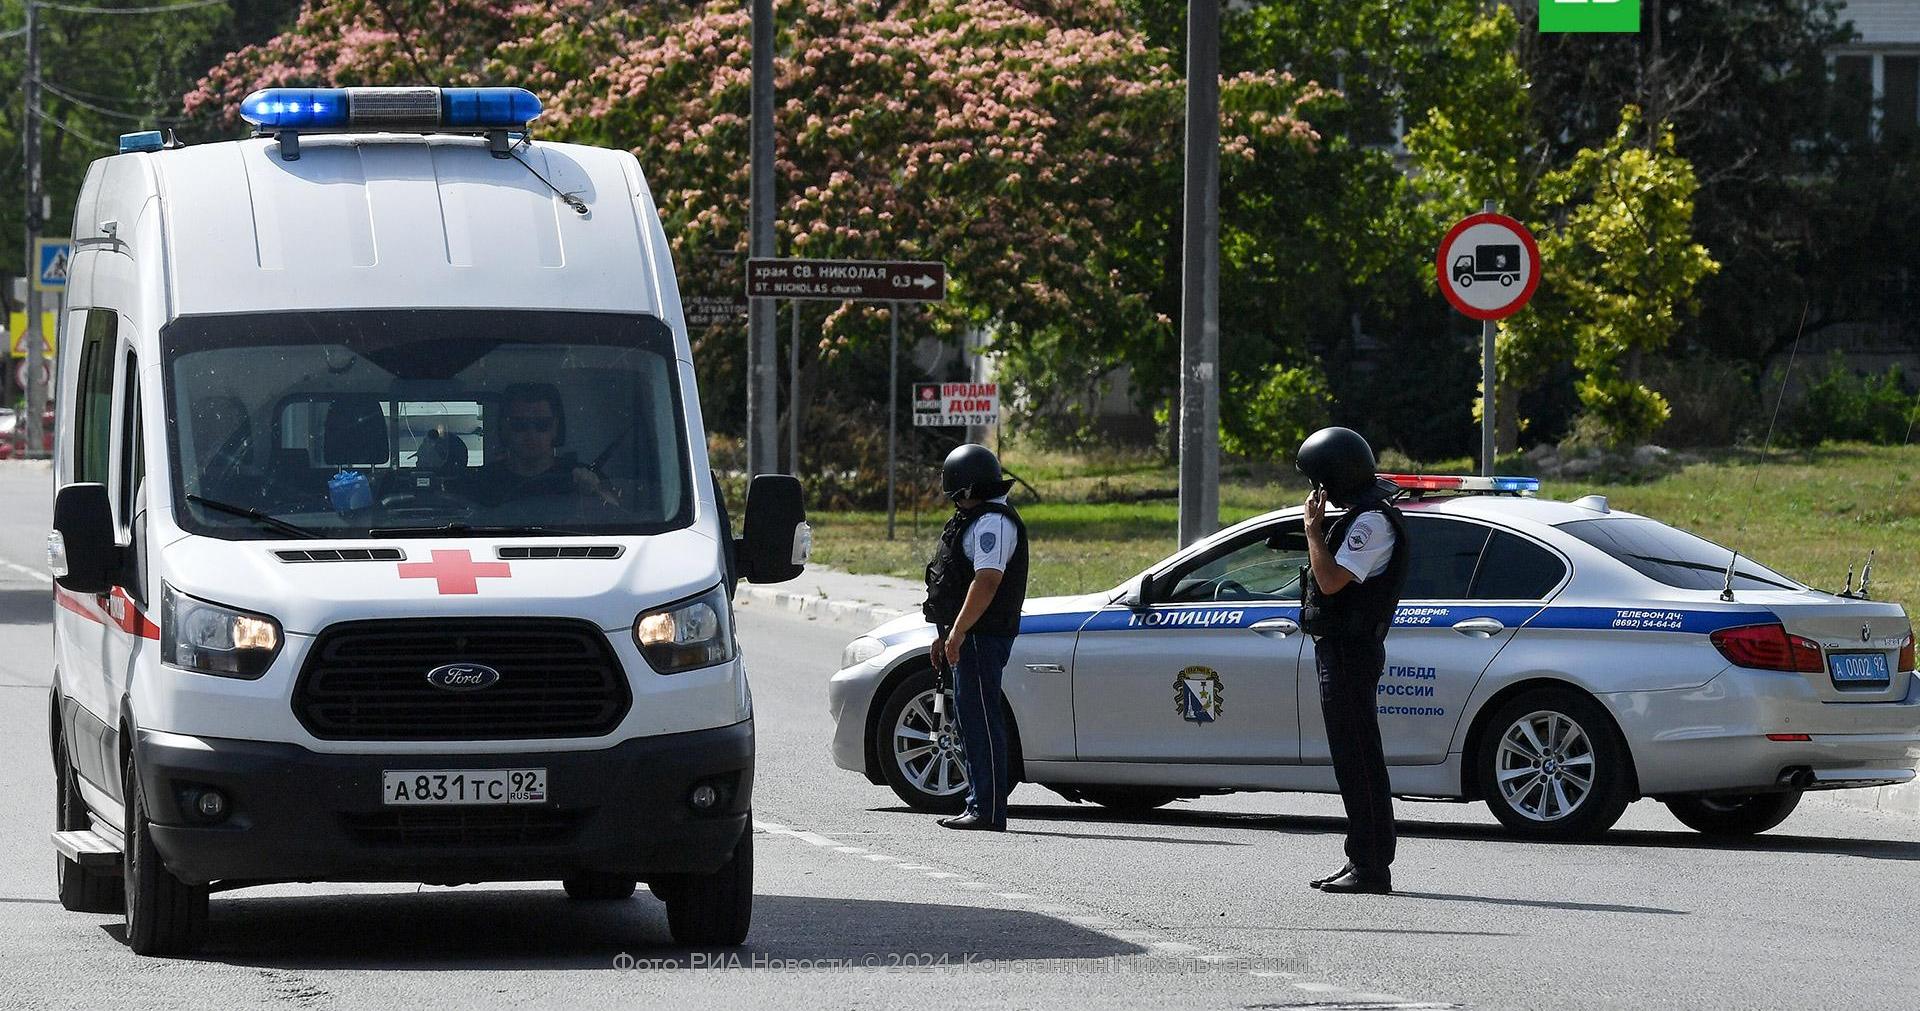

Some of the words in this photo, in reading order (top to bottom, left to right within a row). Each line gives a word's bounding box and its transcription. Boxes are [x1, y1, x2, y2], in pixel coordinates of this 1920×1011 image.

[792, 265, 813, 278] СВ.
[819, 267, 887, 279] НИКОЛАЯ
[774, 283, 828, 294] NICHOLAS
[943, 384, 996, 398] ПРОДАМ
[949, 400, 991, 413] ДОМ
[969, 415, 982, 424] 70
[1400, 608, 1450, 616] ДОВЕРИЯ:
[1616, 610, 1665, 619] ТЕЛЕФОН
[1665, 612, 1684, 620] ДЧ:
[1128, 611, 1244, 627] ПОЛИЦИЯ
[1612, 619, 1640, 628] (8692)
[1642, 620, 1682, 628] 54-64-64
[1845, 658, 1872, 676] 0002
[1873, 656, 1885, 671] 92
[444, 667, 482, 684] Ford
[1389, 666, 1436, 680] ГИБДД
[1377, 684, 1434, 697] РОССИИ
[511, 772, 538, 792] 92
[510, 792, 530, 800] RUS
